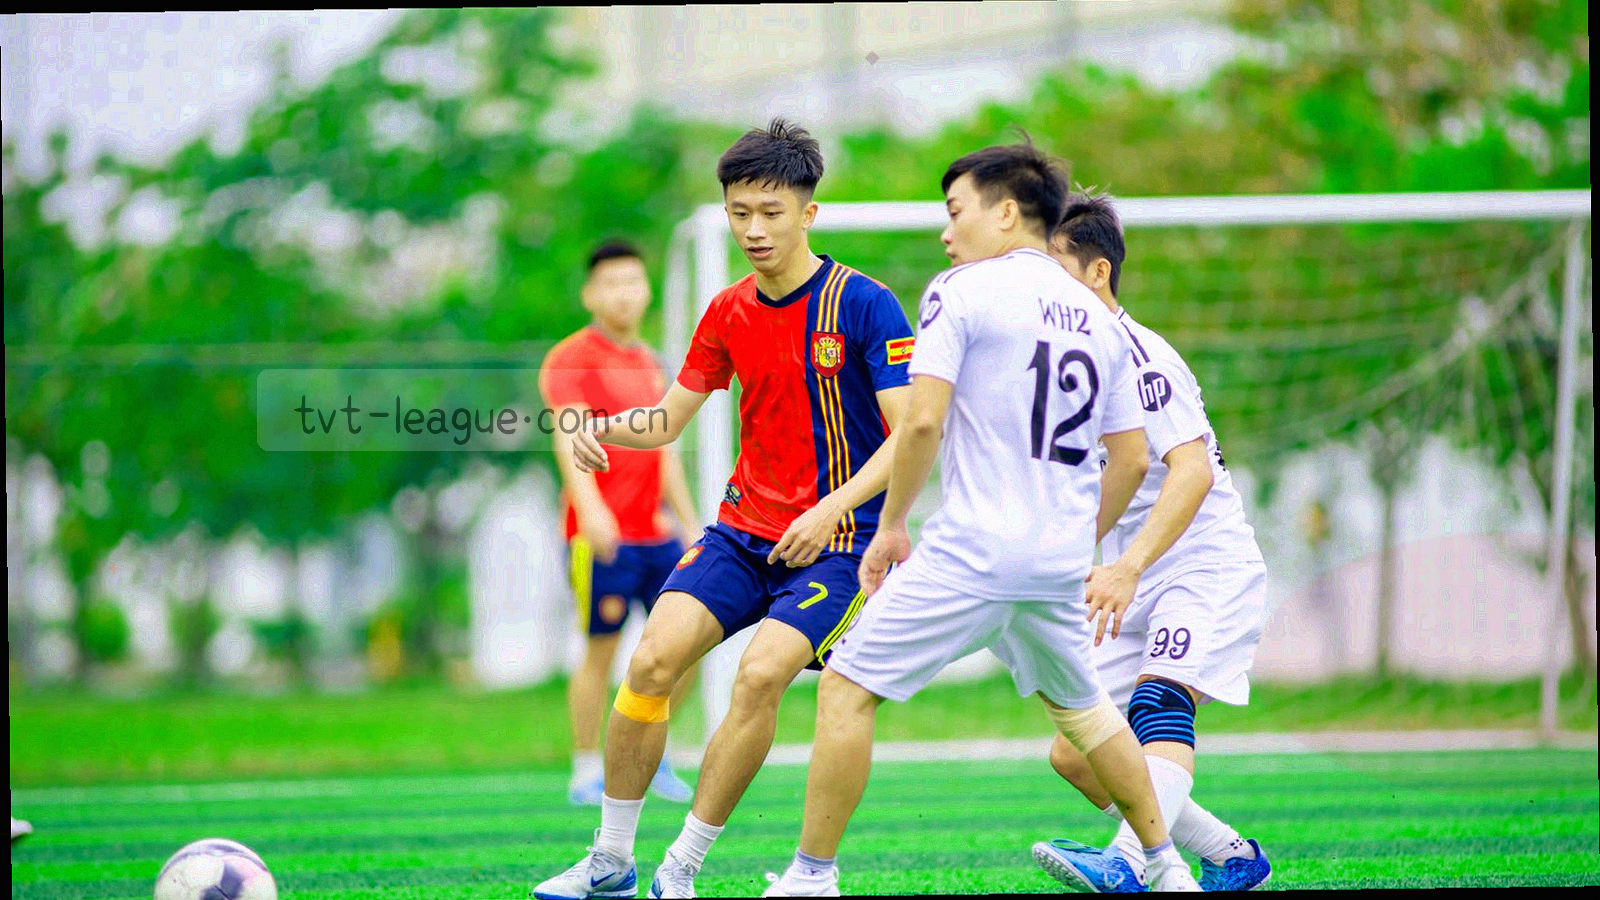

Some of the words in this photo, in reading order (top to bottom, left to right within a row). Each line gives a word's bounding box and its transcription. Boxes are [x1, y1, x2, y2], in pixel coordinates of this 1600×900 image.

[1038, 297, 1092, 336] WH2
[1026, 340, 1099, 467] 12
[1138, 372, 1169, 412] hp
[797, 581, 829, 610] 7
[1150, 627, 1191, 660] 99
